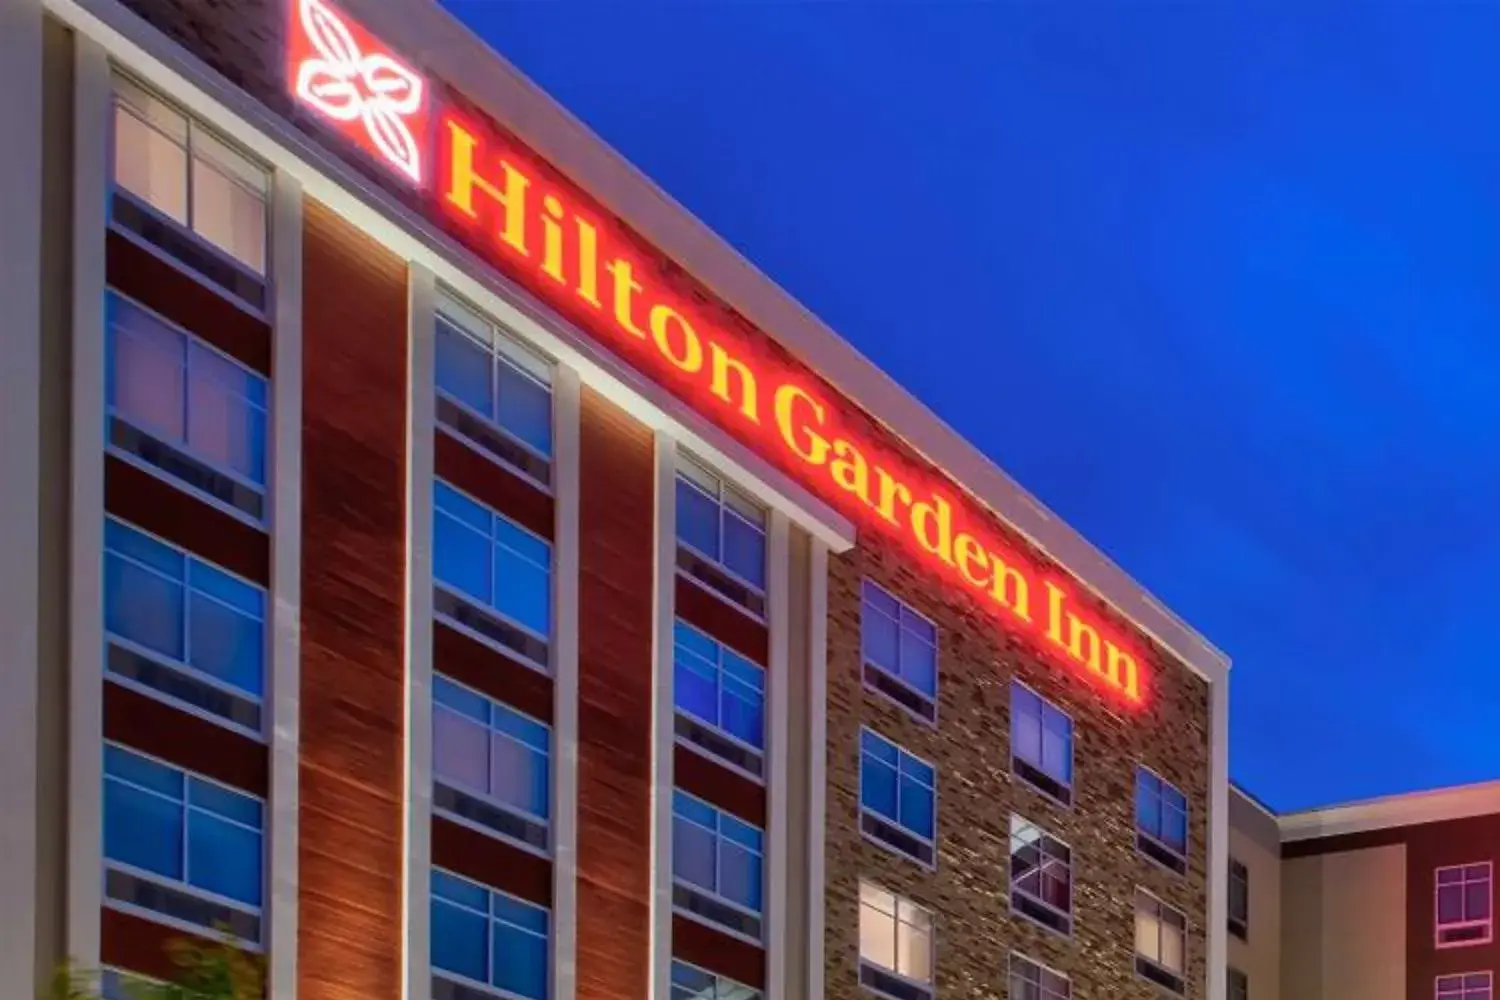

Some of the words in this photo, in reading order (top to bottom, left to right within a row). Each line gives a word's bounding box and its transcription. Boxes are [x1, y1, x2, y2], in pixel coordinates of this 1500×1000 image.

[445, 119, 761, 425] Hilton
[773, 384, 1033, 623] Garden
[1044, 580, 1143, 702] Inn
